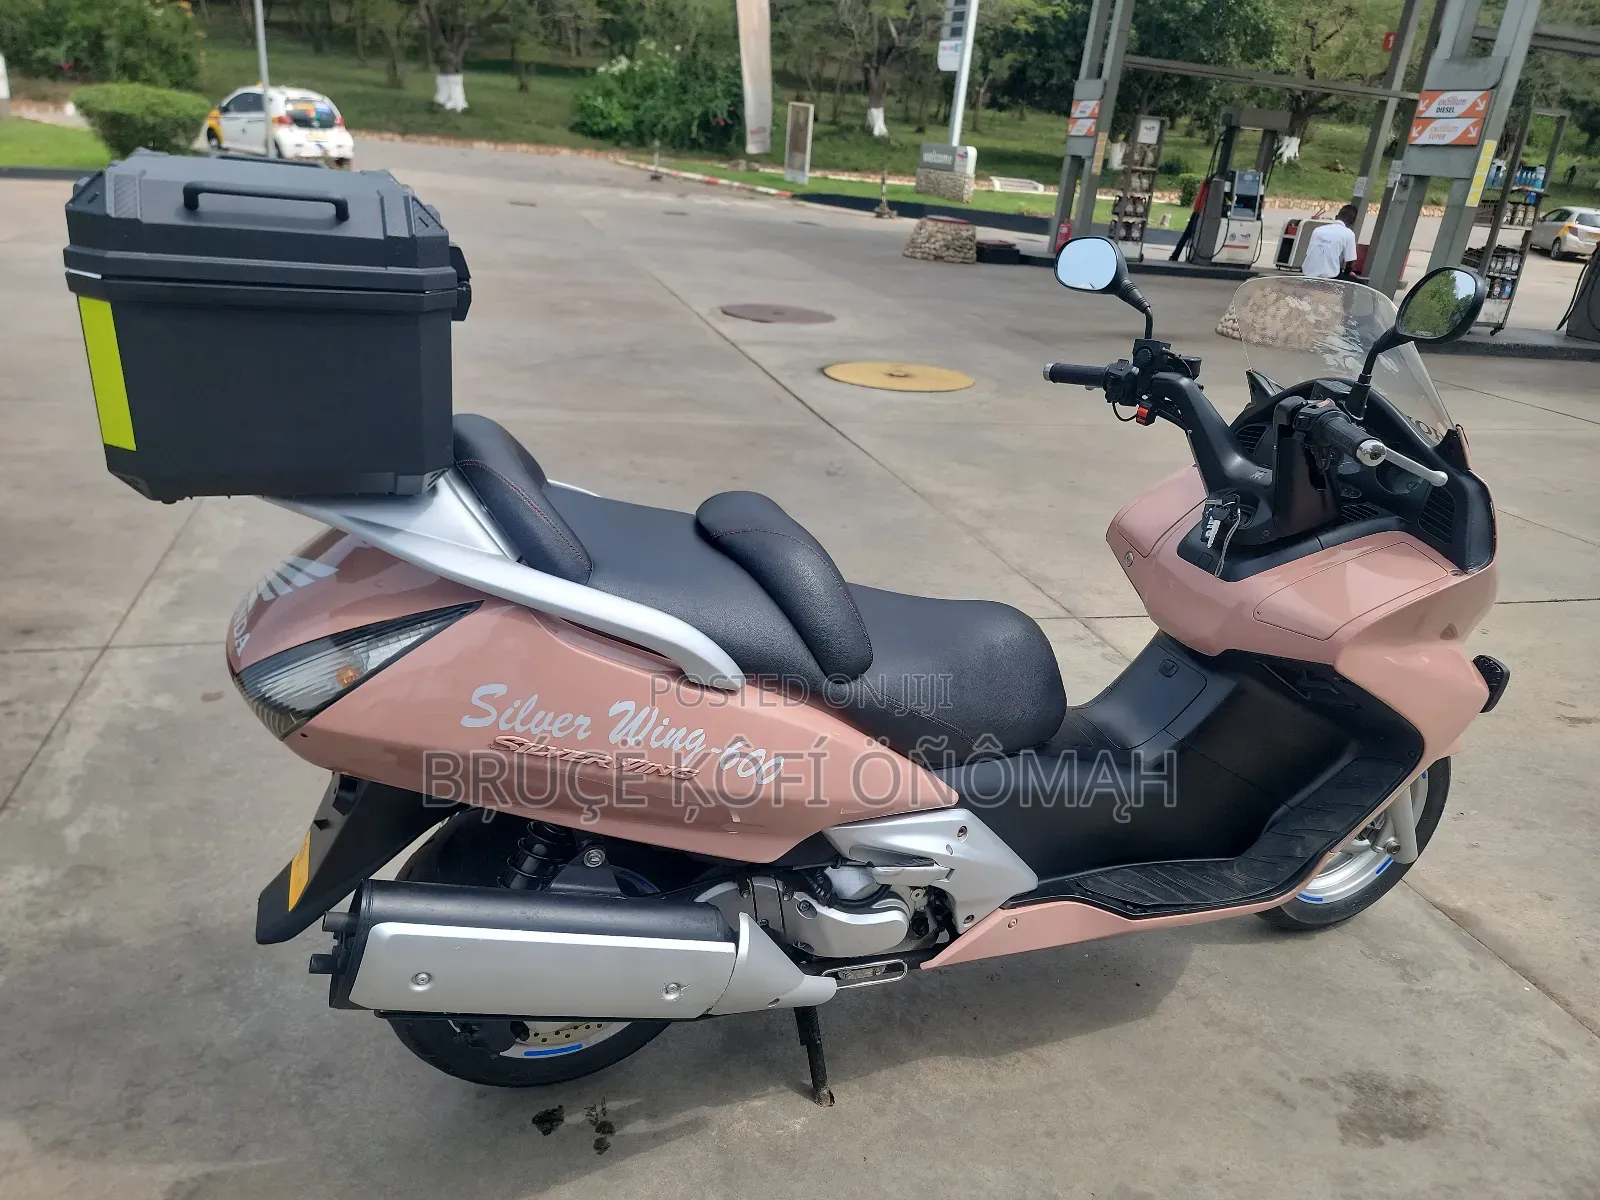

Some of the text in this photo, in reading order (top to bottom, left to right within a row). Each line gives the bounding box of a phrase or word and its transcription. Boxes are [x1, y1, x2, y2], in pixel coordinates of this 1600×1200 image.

[1435, 106, 1456, 114] DIESEL
[922, 150, 953, 165] welcome
[459, 683, 593, 741] Silver
[488, 734, 701, 781] SILVER WING
